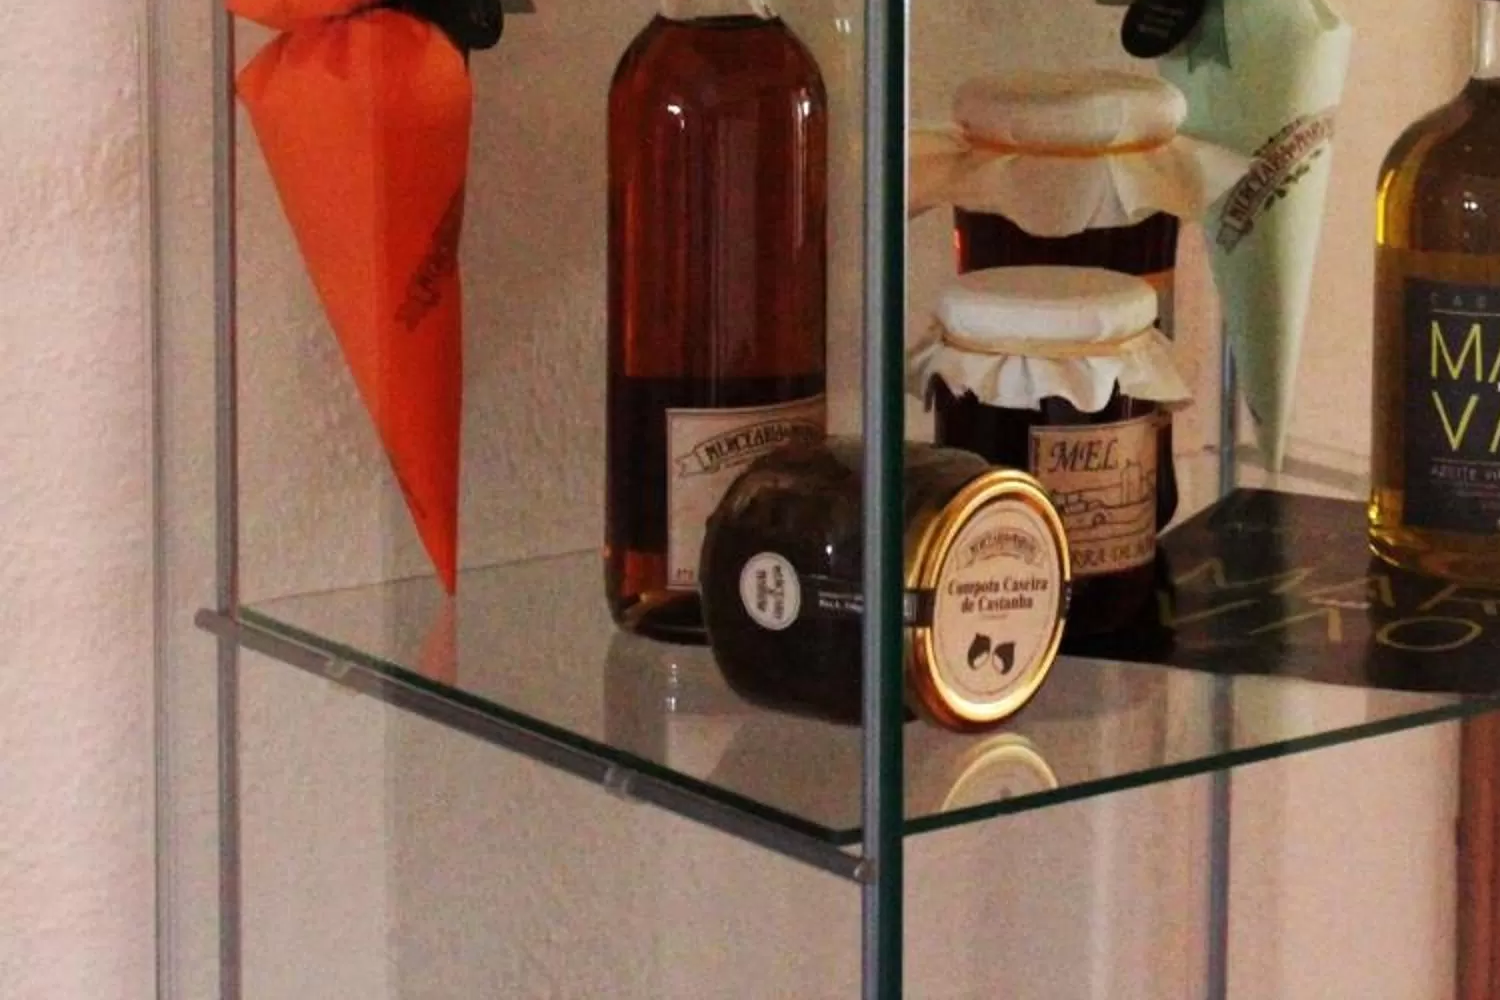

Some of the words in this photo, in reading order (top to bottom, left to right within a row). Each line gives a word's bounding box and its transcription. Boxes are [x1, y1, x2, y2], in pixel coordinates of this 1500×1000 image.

[1048, 438, 1118, 473] MEL
[947, 577, 1000, 598] Compota
[1003, 576, 1049, 592] Caseira
[961, 597, 975, 614] de
[978, 593, 1035, 612] Castanha
